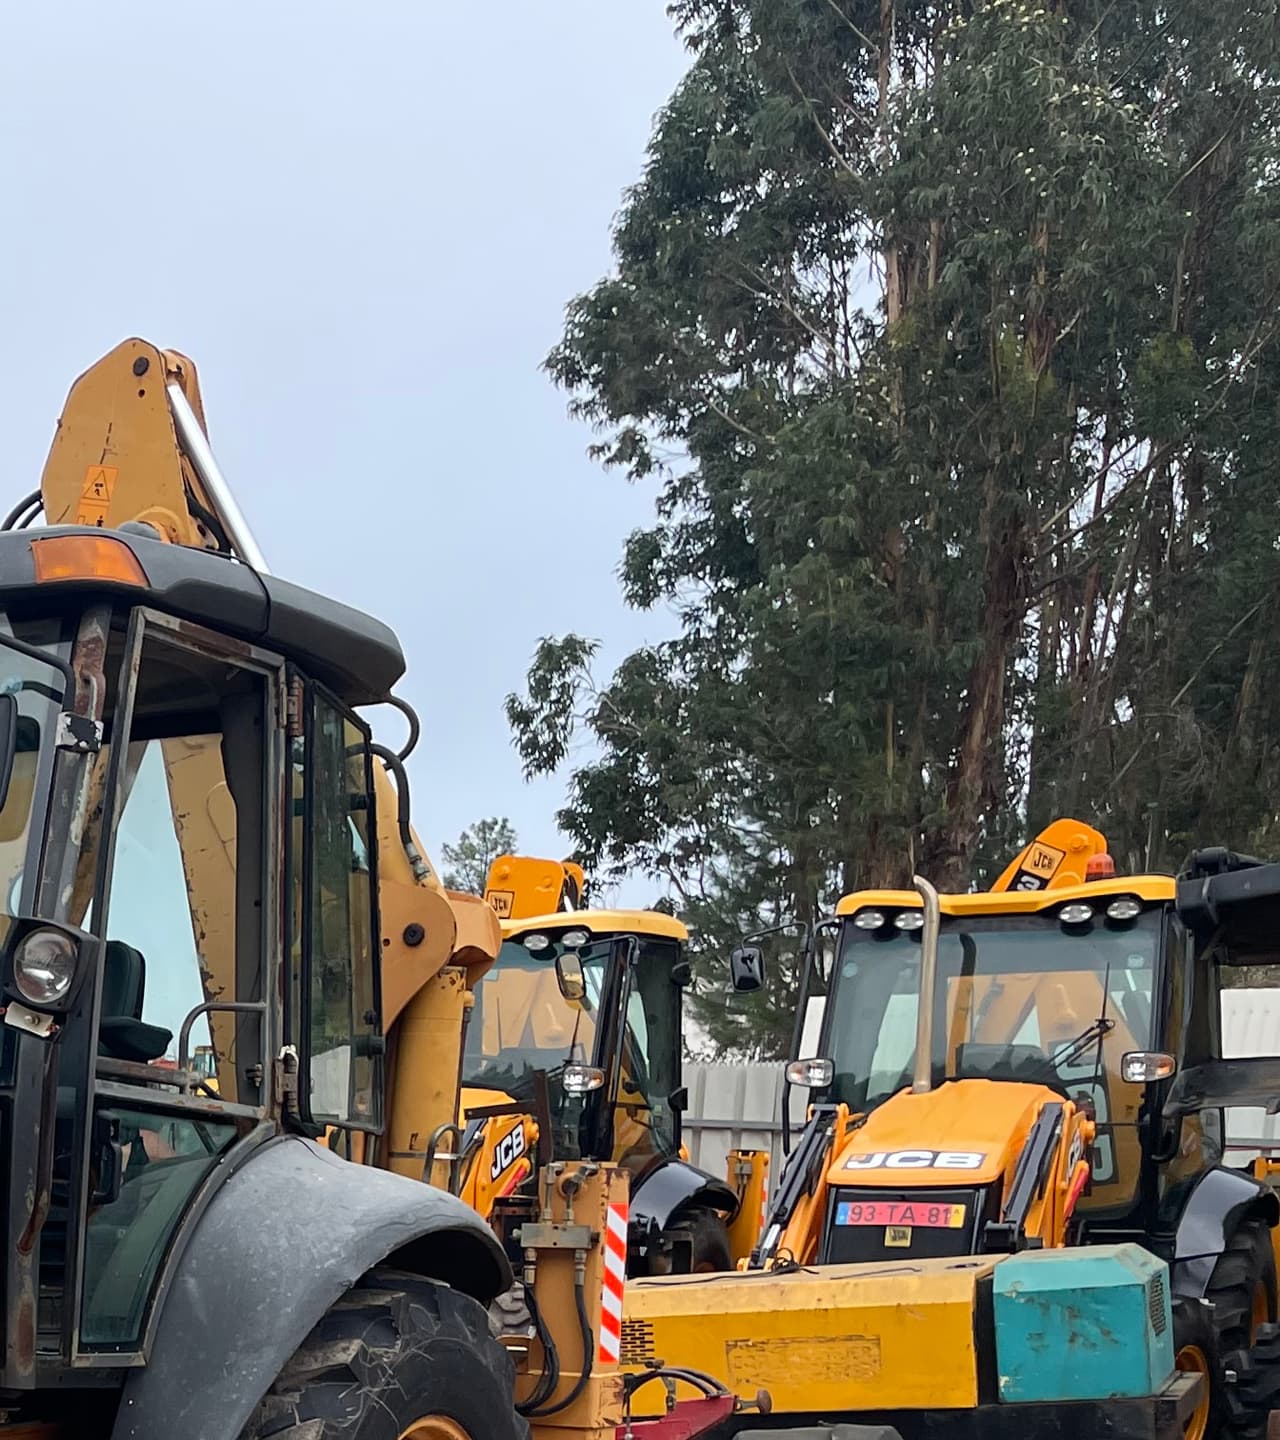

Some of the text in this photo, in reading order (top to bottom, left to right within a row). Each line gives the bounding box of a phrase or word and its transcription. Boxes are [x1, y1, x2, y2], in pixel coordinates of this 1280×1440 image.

[491, 1123, 525, 1179] JCB
[845, 1150, 985, 1170] JCB
[850, 1205, 951, 1225] 93-TA-81
